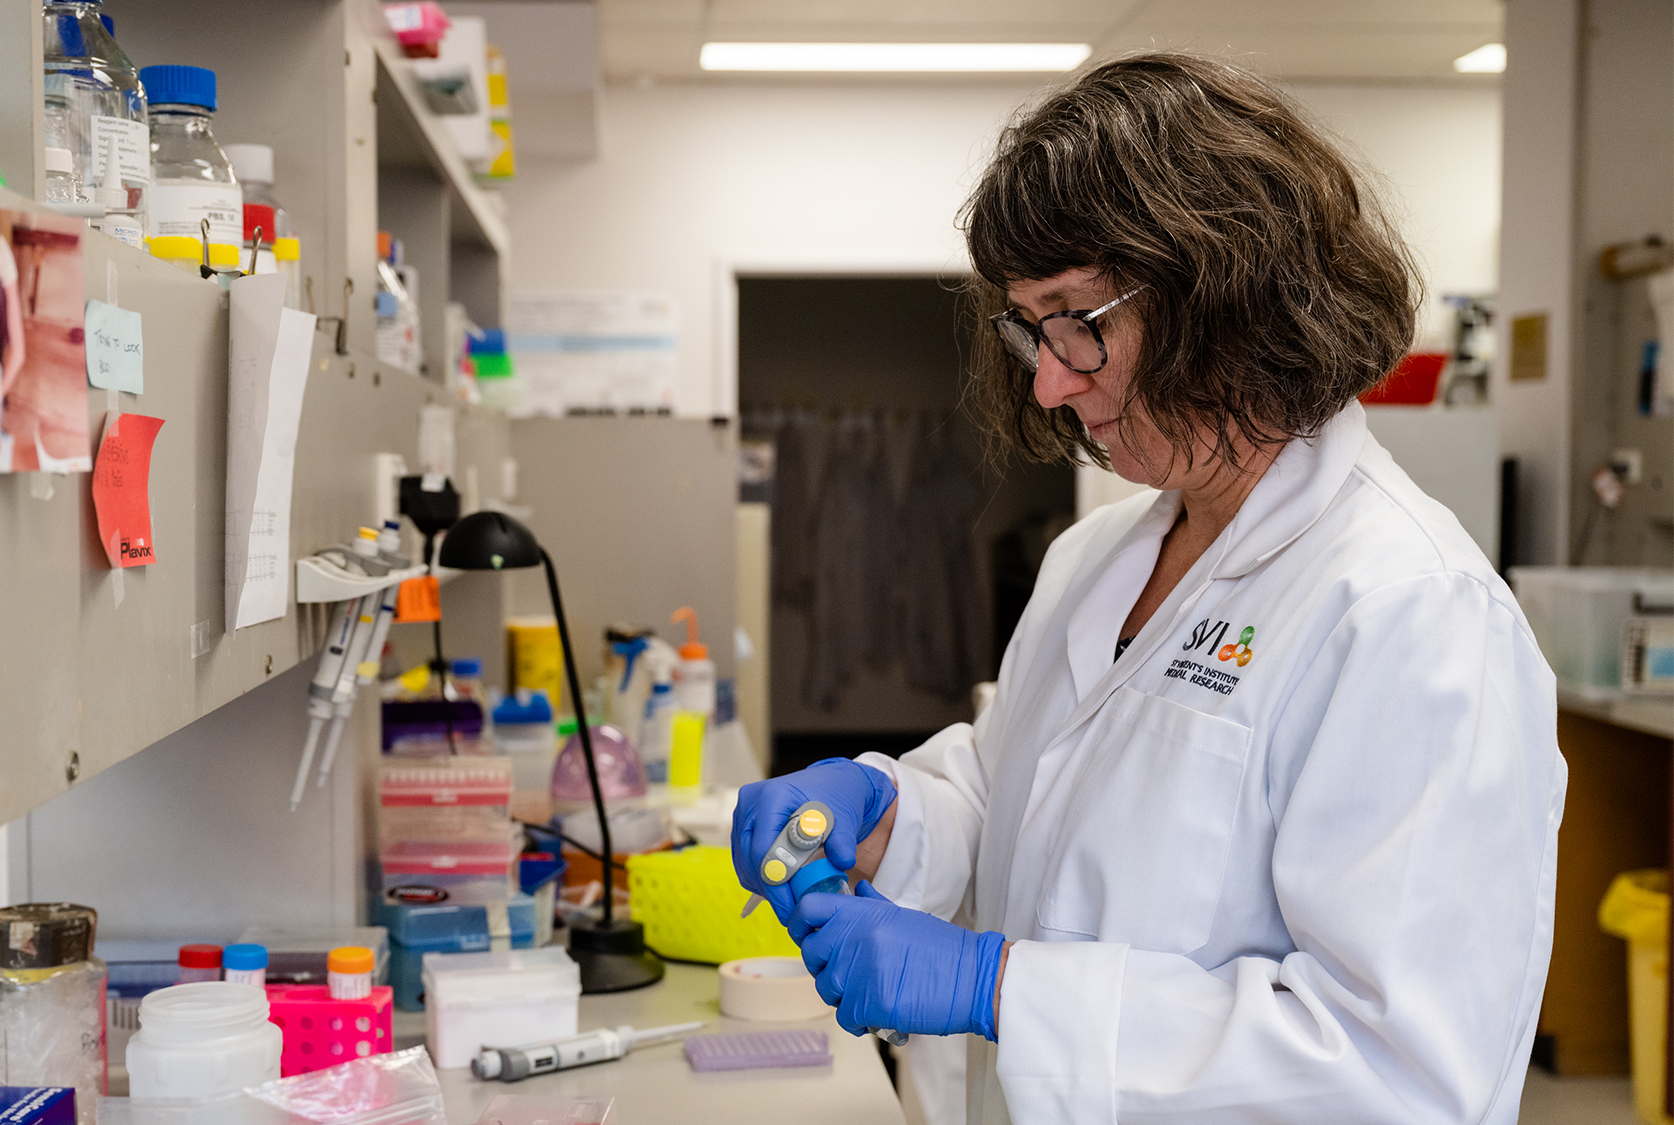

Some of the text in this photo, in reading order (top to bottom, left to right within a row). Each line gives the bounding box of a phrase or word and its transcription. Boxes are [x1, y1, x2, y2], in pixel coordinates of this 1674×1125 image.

[124, 343, 141, 356] LOOK
[120, 541, 152, 560] Plavix
[1182, 618, 1230, 656] SVI
[1189, 674, 1235, 696] RESEARCH
